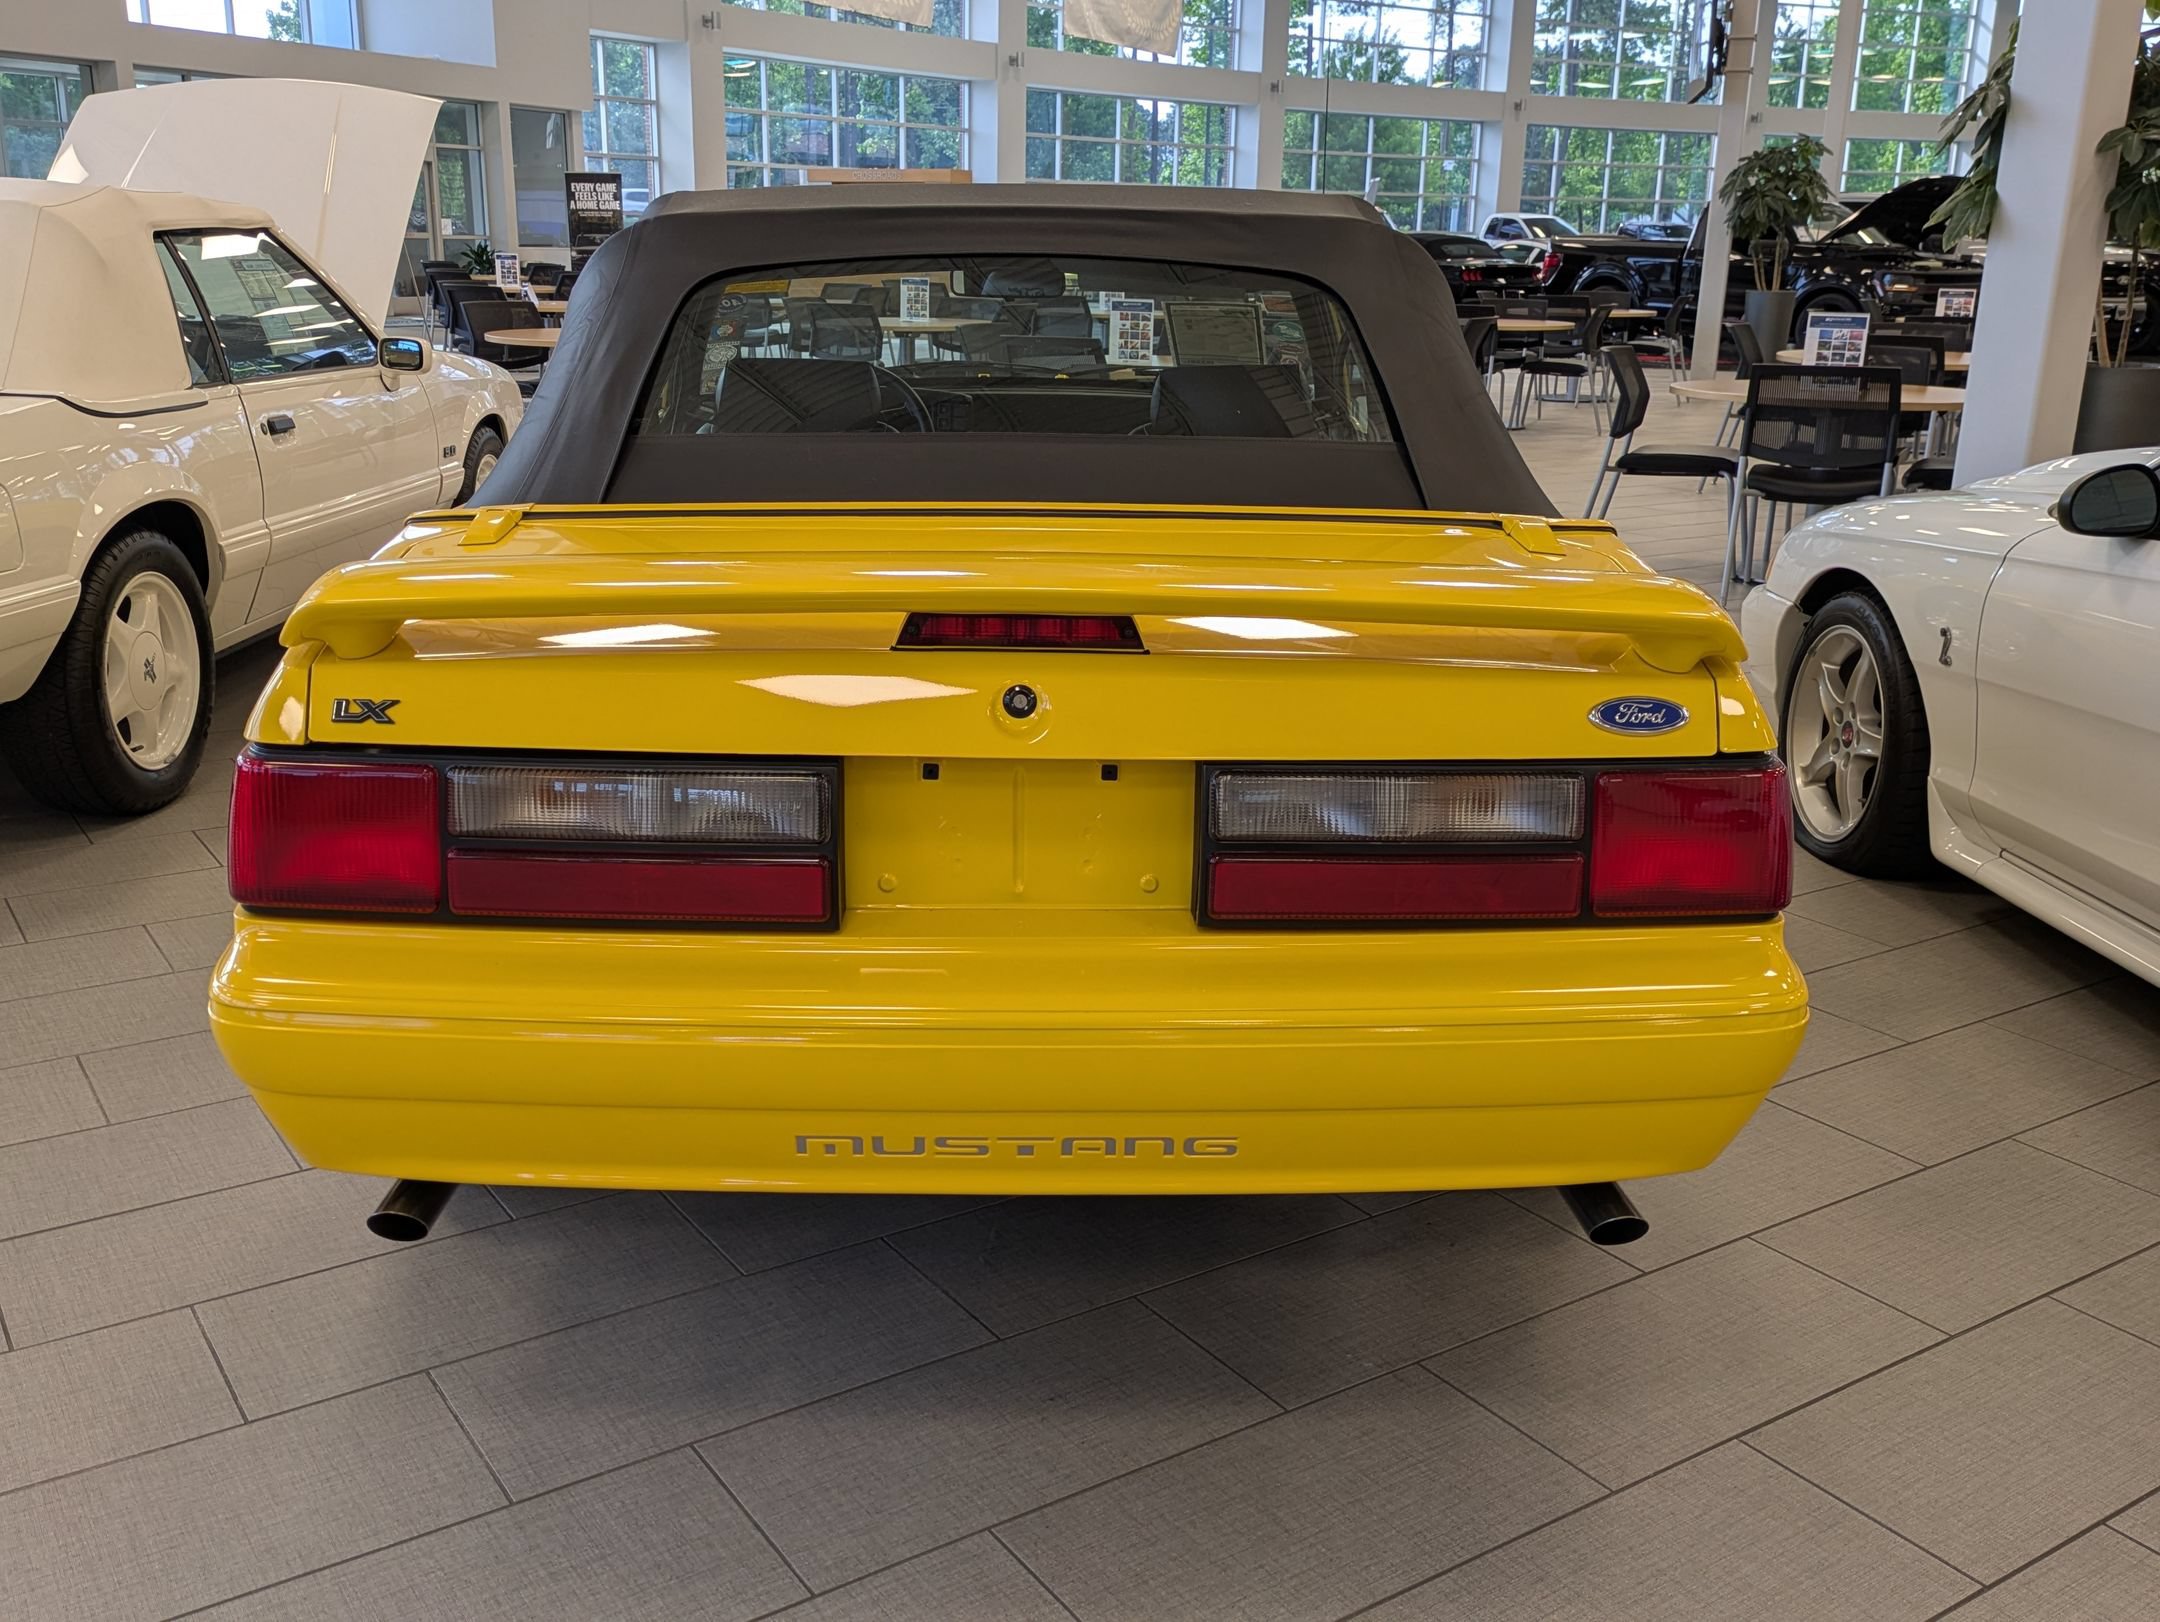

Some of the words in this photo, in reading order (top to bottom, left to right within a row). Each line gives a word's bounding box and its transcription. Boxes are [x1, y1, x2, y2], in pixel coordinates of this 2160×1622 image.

[570, 182, 595, 193] EVERY
[595, 183, 617, 193] GAME
[575, 192, 597, 201] FEELS
[598, 192, 614, 201] LIKE
[570, 200, 576, 210] A
[576, 201, 598, 210] HOME
[599, 201, 620, 210] GAME
[331, 698, 401, 724] LX
[1614, 702, 1667, 724] Ford
[794, 1135, 1240, 1158] MUSTANG
